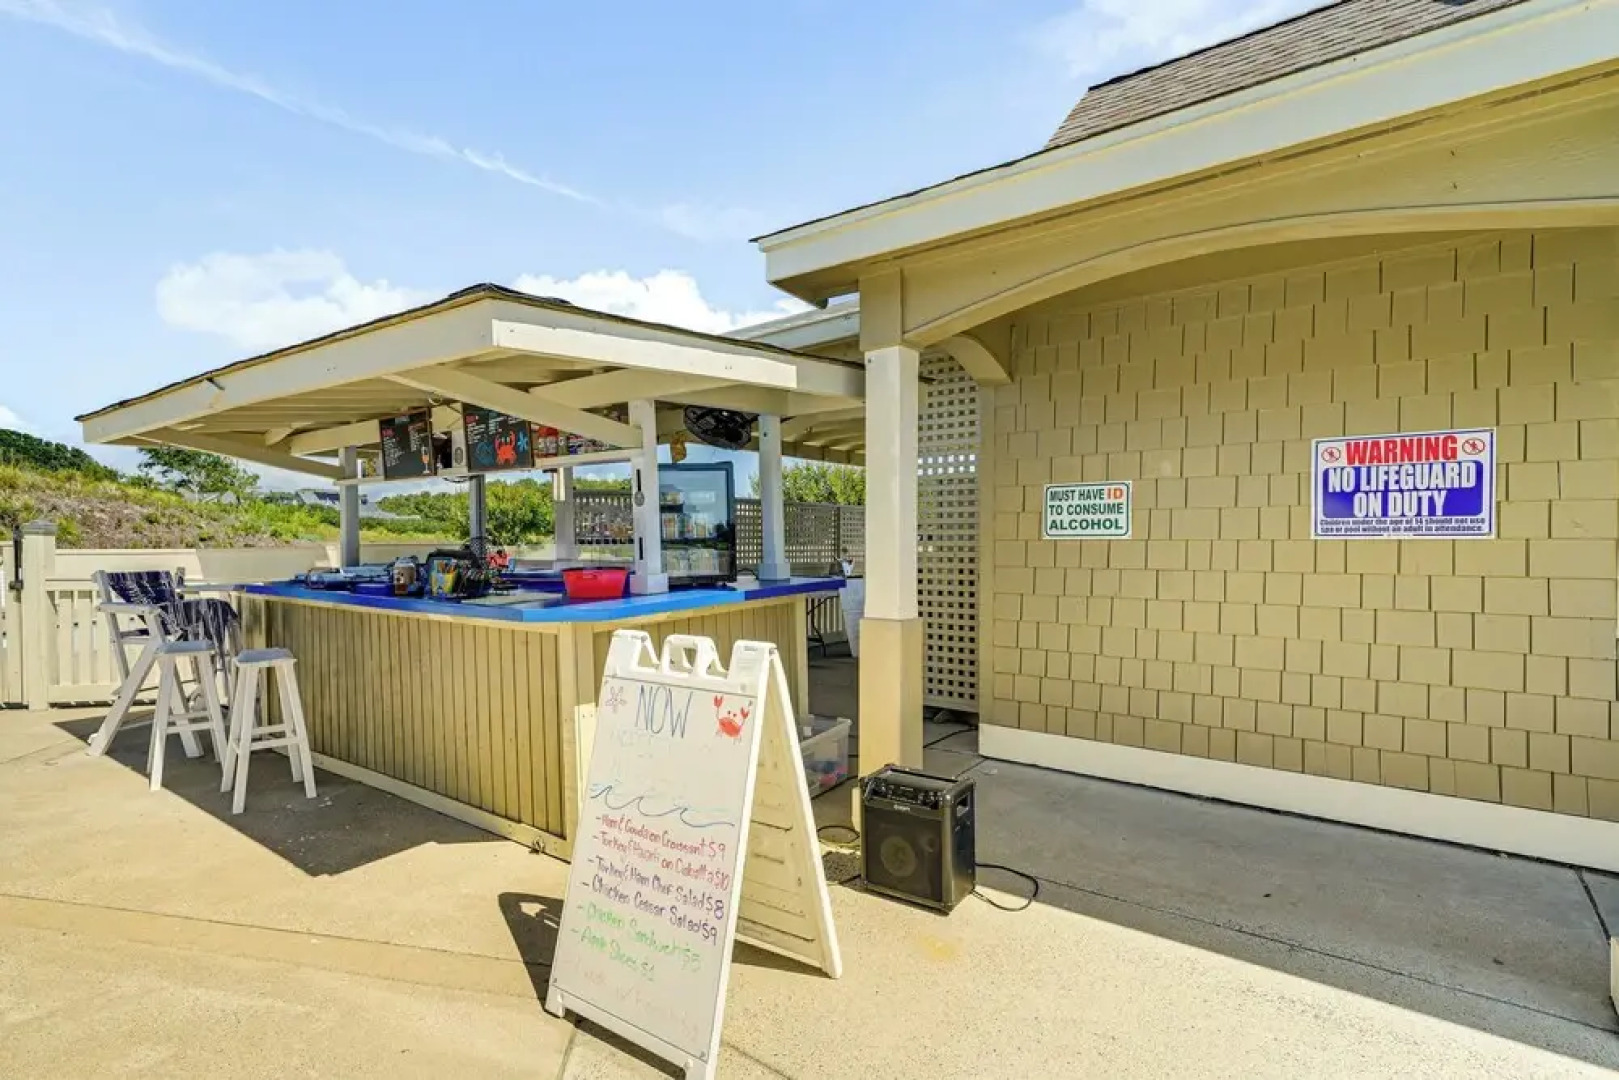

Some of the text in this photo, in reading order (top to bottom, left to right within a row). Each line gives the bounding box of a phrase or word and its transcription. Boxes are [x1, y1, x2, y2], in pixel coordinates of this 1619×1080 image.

[1346, 435, 1458, 466] WARNING
[1328, 461, 1476, 493] NO LIFEGUARD
[1049, 487, 1123, 502] MUST HAVE ID
[1353, 490, 1447, 517] ON DUTY
[1049, 502, 1124, 515] TO CONSUME
[1049, 517, 1124, 530] ALCOHOL
[1320, 518, 1350, 526] Children
[1351, 517, 1374, 526] under
[1375, 517, 1389, 526] the
[1390, 518, 1403, 527] age
[1404, 517, 1414, 526] of
[1425, 517, 1453, 525] should
[1454, 517, 1468, 525] not
[1469, 517, 1486, 525] use
[1344, 526, 1360, 534] pool
[1361, 525, 1390, 533] without
[634, 684, 694, 739] NOW
[660, 858, 675, 870] on
[630, 866, 650, 887] Ham
[675, 885, 705, 910] Salad
[705, 893, 725, 921] $8
[669, 904, 702, 933] Salad
[701, 917, 718, 947] $9
